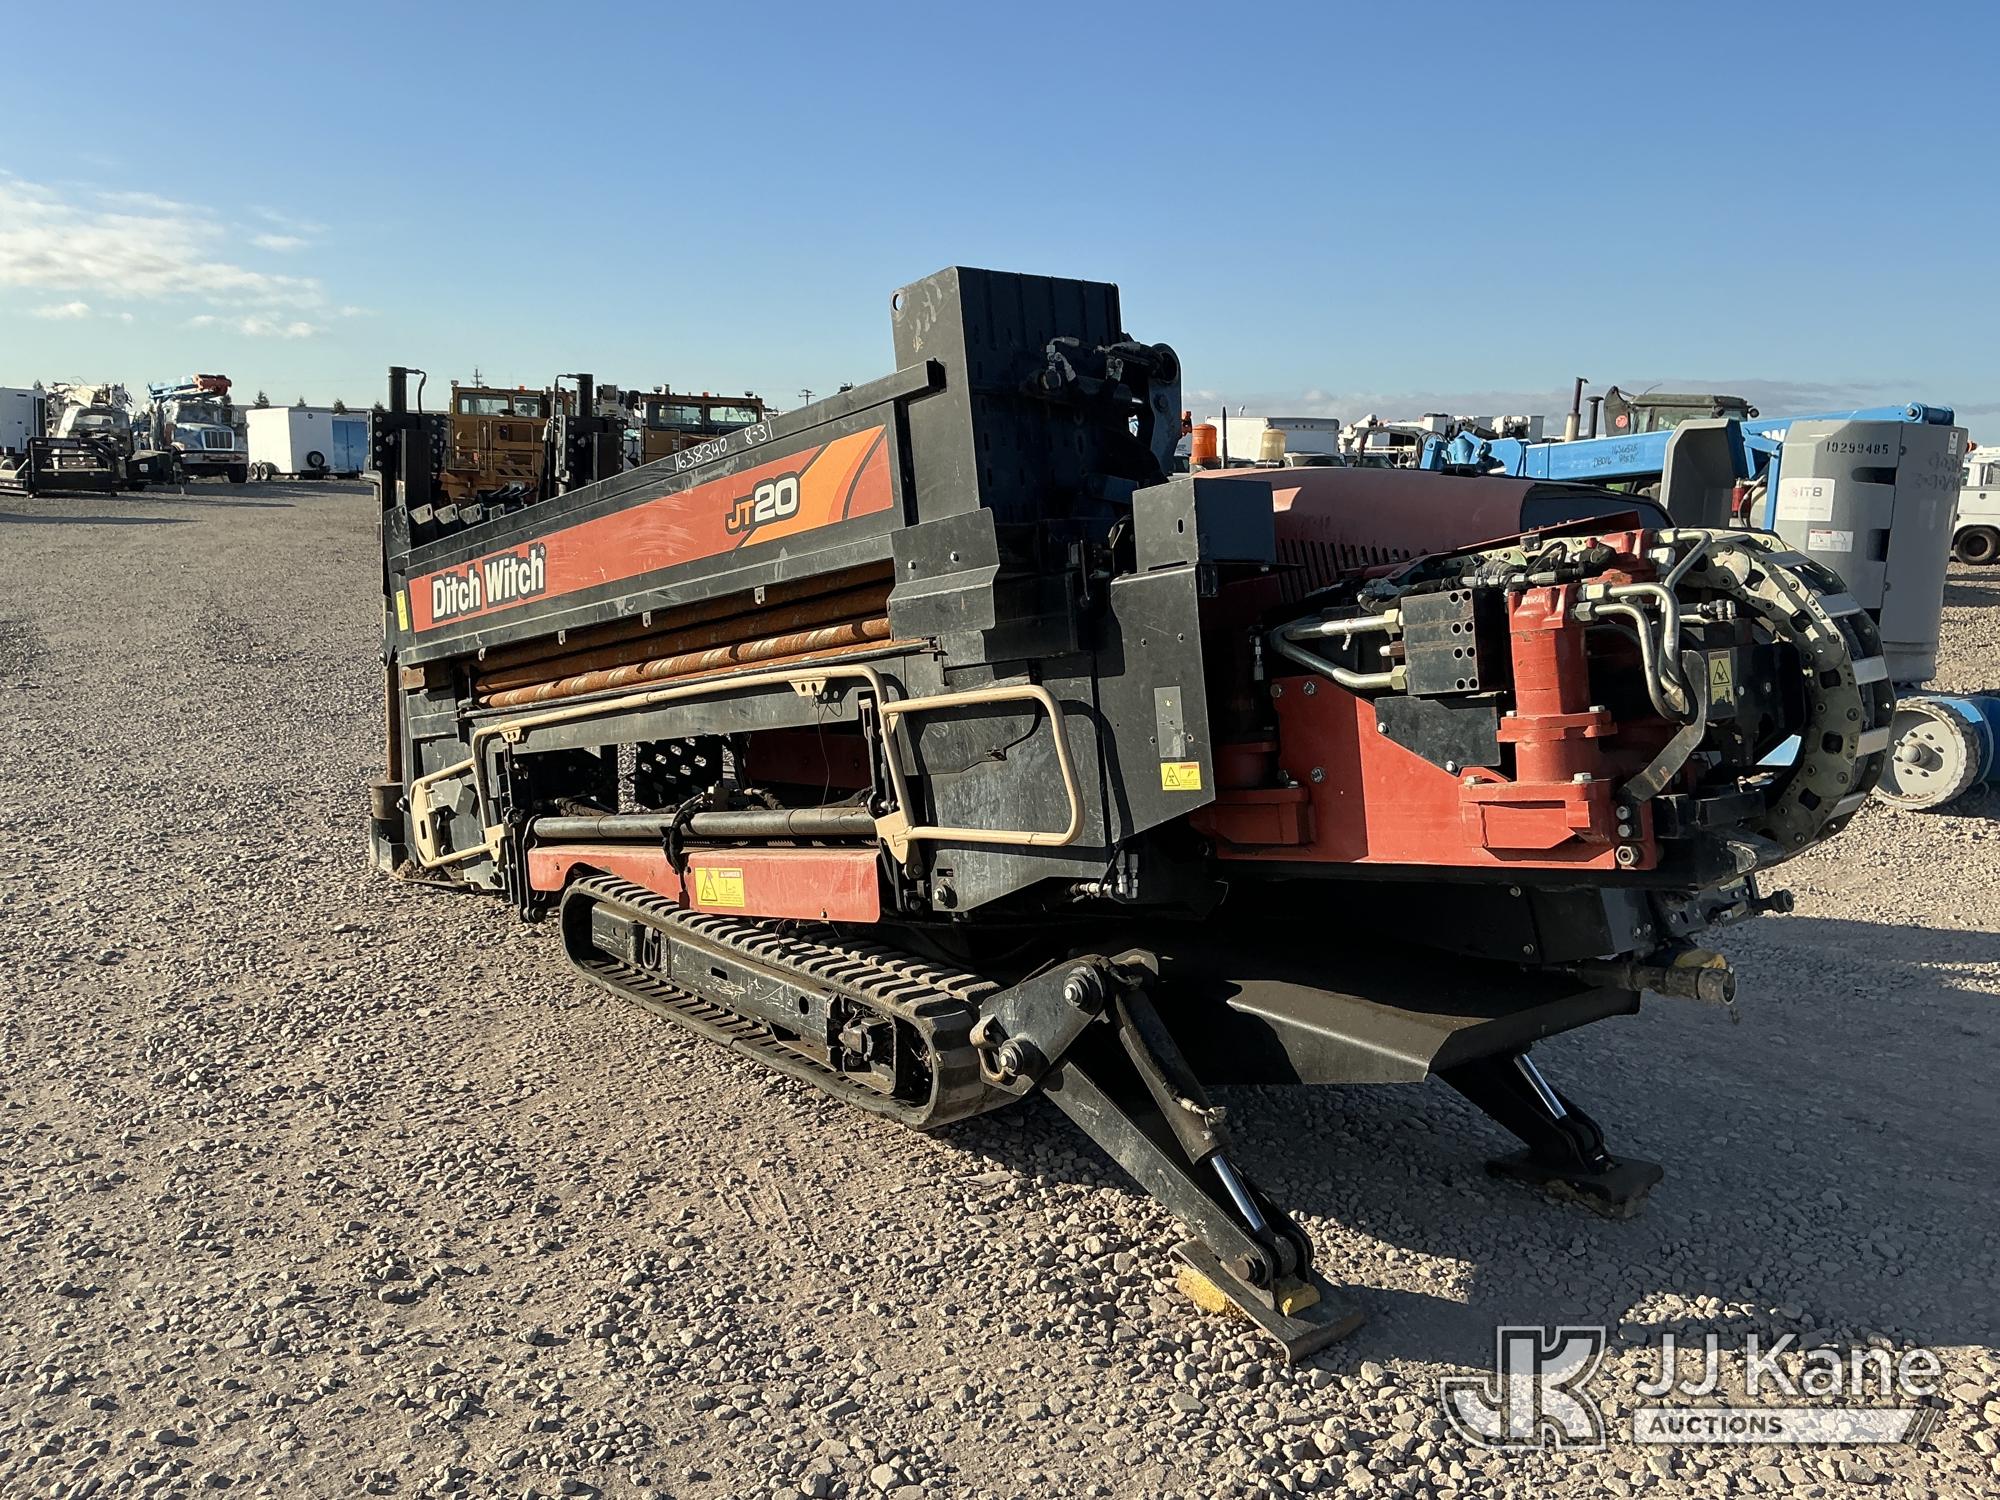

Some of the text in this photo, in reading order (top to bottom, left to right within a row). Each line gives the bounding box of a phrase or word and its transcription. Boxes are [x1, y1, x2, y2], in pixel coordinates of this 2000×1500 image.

[674, 420, 773, 473] 1638340 8-31
[1826, 441, 1889, 455] 10299485
[727, 477, 798, 530] JT20
[432, 569, 480, 619] Ditch
[484, 549, 544, 603] Witch
